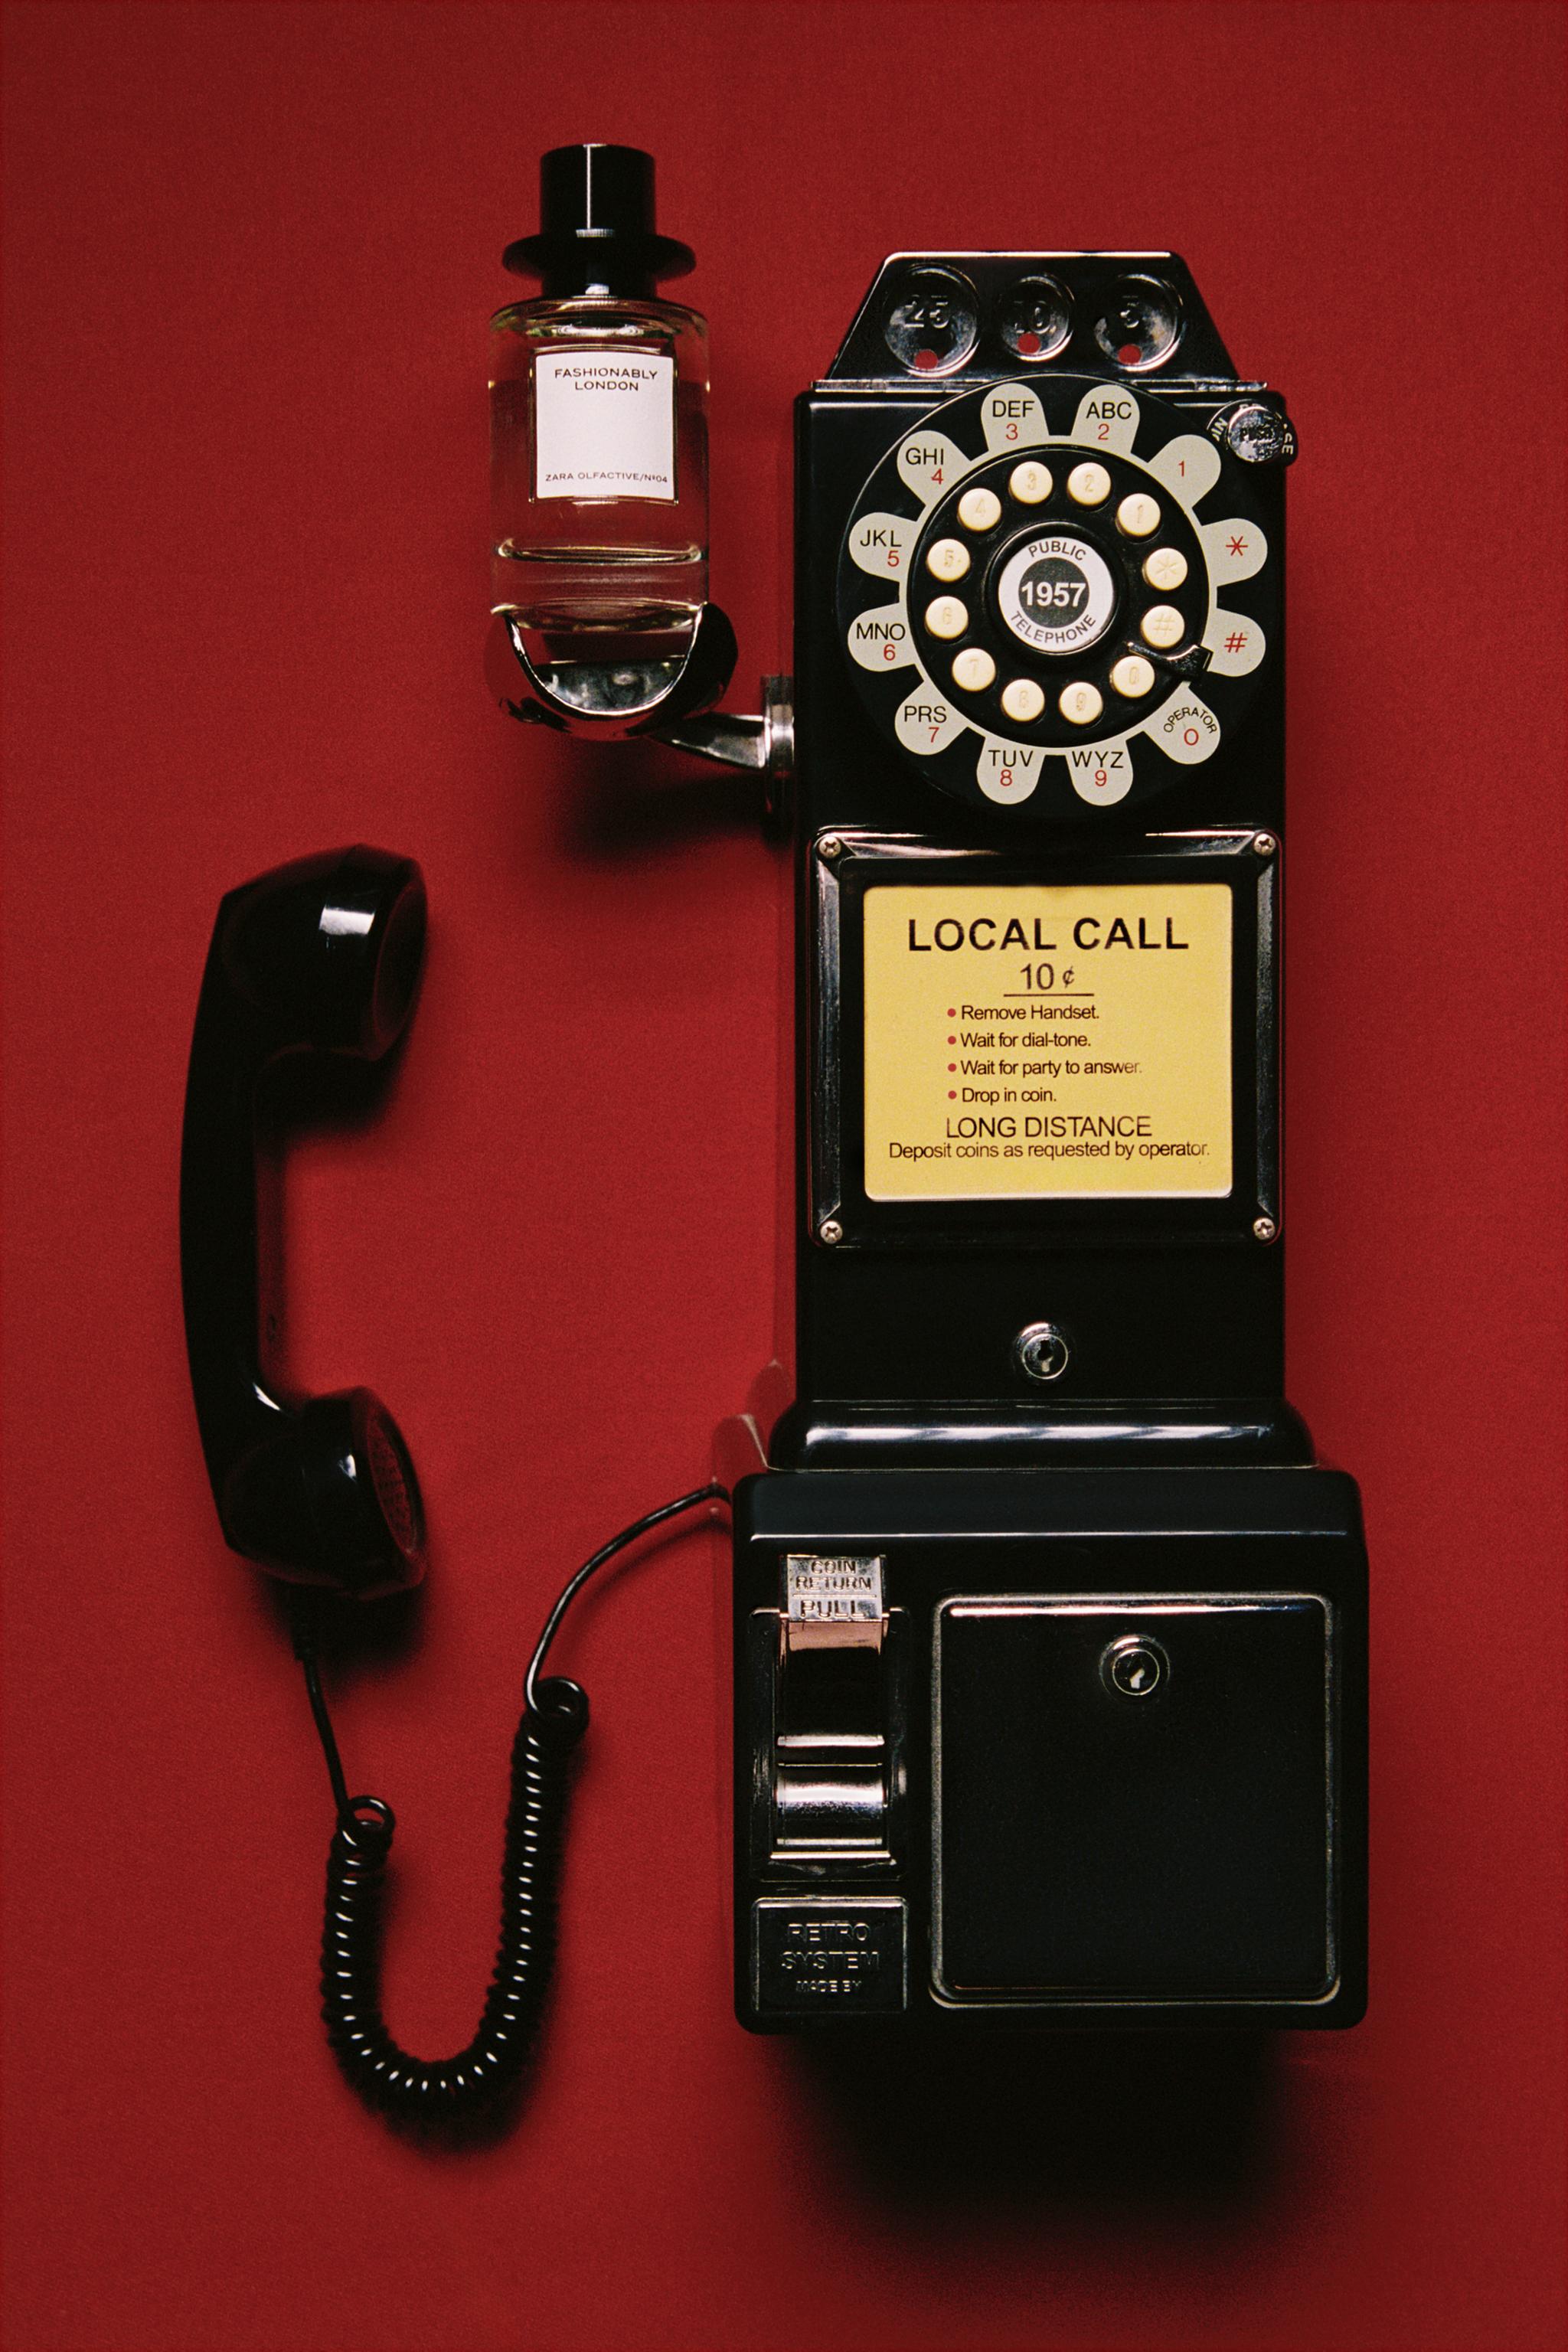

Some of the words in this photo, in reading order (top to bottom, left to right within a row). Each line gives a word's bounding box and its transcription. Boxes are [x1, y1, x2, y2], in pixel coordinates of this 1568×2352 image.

[555, 368, 657, 379] FASHIONABLY
[575, 381, 638, 390] LONDON
[993, 400, 1034, 417] DEF
[1086, 401, 1132, 420] ABC
[1006, 423, 1018, 441] 3
[1098, 423, 1110, 441] 2
[905, 448, 944, 466] GHI
[931, 468, 943, 484] 4
[1179, 461, 1185, 478] 1
[1024, 468, 1040, 492] 3
[1083, 472, 1095, 493] 2
[975, 498, 988, 518] 4
[861, 530, 901, 547] JKL
[887, 549, 900, 567] 5
[1028, 540, 1086, 560] PUBLIC
[1021, 581, 1086, 607] 1957
[857, 623, 905, 640] MNO
[1011, 611, 1096, 643] TELEPHONE
[884, 643, 895, 662] 6
[903, 706, 947, 724] PRS
[1163, 707, 1217, 735] OPERATOR
[930, 726, 939, 743] 7
[988, 750, 1033, 767] TUV
[1072, 751, 1123, 768] WYZ
[1000, 769, 1013, 787] 8
[1095, 769, 1107, 787] 9
[910, 918, 1057, 951] LOCAL
[1073, 918, 1188, 949] CALL
[1021, 963, 1054, 990] 10
[1062, 965, 1076, 988] ¢
[962, 1005, 1026, 1020] Remove
[1031, 1004, 1099, 1019] Handset.
[961, 1033, 995, 1047] Wait
[998, 1032, 1018, 1047] for
[1022, 1032, 1090, 1047] dial-tone.
[961, 1060, 995, 1075] Wait
[999, 1060, 1018, 1074] for
[1023, 1060, 1061, 1078] party
[1066, 1060, 1080, 1074] to
[1083, 1062, 1142, 1074] answer.
[962, 1088, 999, 1106] Drop
[1004, 1088, 1017, 1102] in
[1021, 1087, 1056, 1102] coin.
[947, 1117, 1016, 1138] LONG
[1025, 1116, 1152, 1137] DISTANCE
[890, 1143, 951, 1161] Deposit
[956, 1142, 998, 1158] coins
[1004, 1145, 1023, 1157] as
[1028, 1141, 1109, 1161] requested
[1116, 1141, 1134, 1160] by
[1138, 1142, 1210, 1160] operator.
[812, 1560, 856, 1574] COIN
[796, 1576, 871, 1592] RETURN
[800, 1600, 864, 1619] PULL
[788, 1922, 871, 1942] RETRO
[781, 1951, 880, 1971] SYSTEM
[796, 1980, 838, 1992] MADE
[841, 1980, 862, 1992] BY
